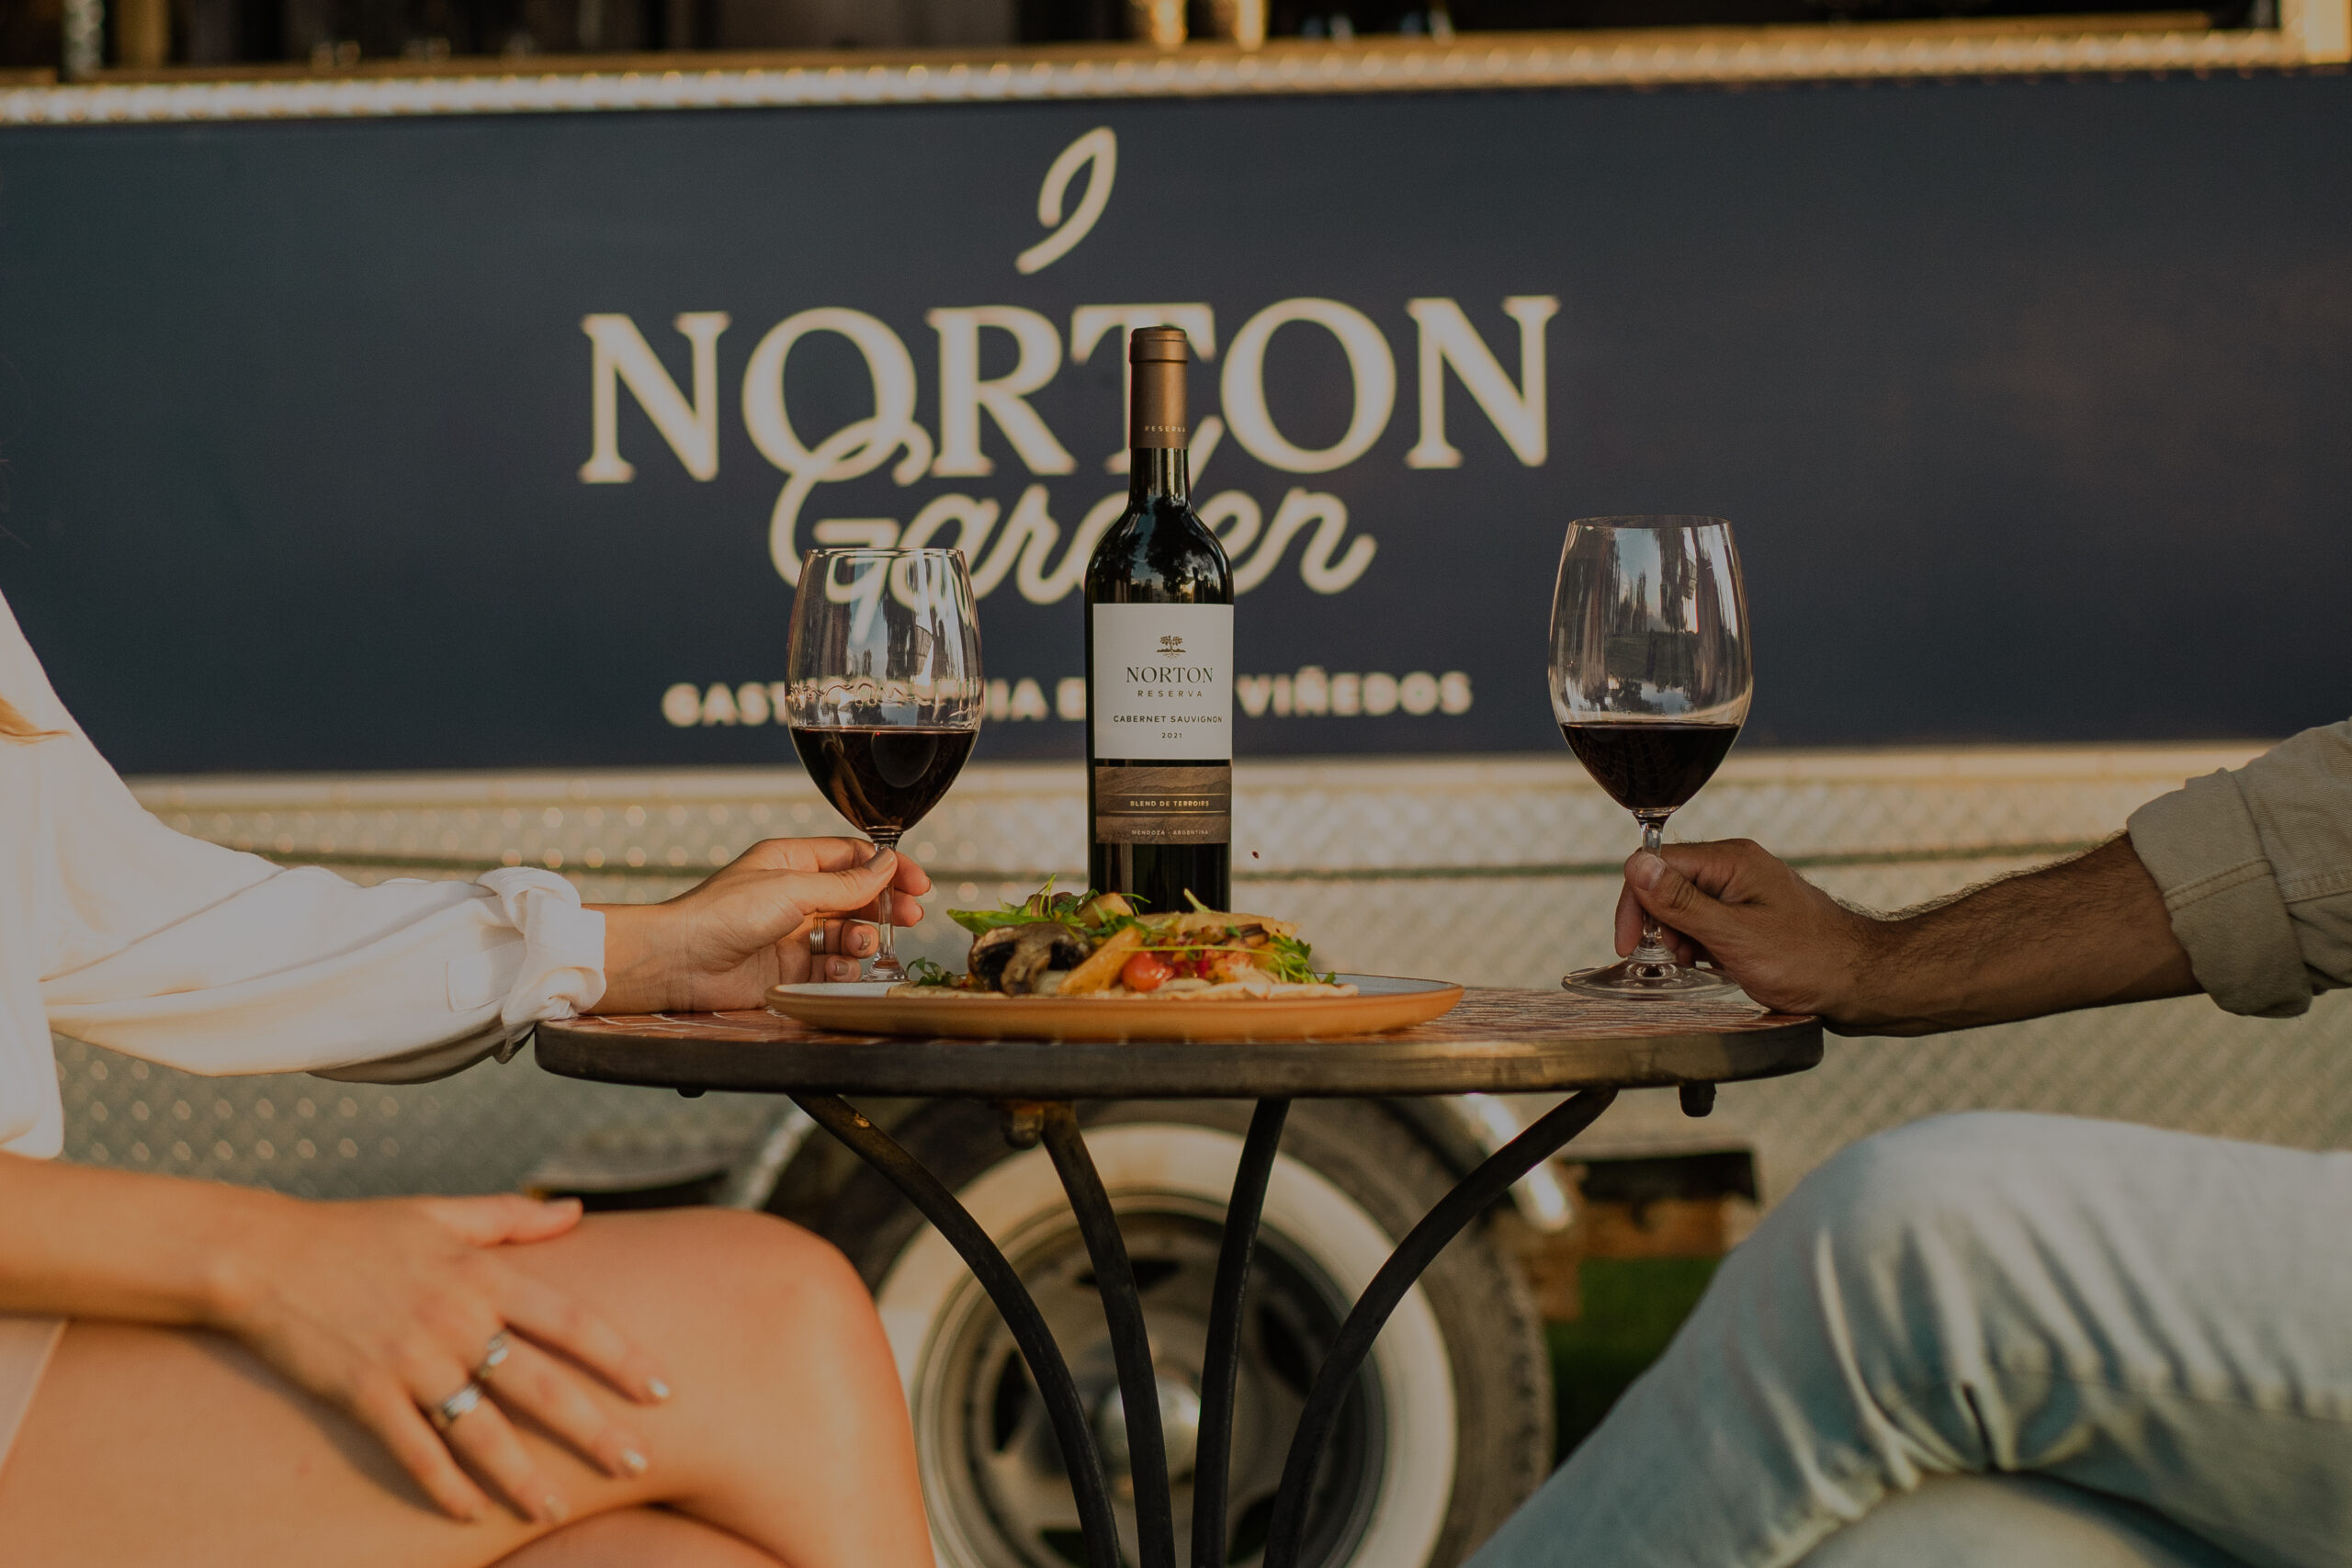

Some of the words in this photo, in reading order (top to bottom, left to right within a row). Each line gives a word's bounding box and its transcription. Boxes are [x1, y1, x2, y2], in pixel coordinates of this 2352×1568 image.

[1126, 666, 1213, 683] NORTON
[1137, 690, 1203, 698] RESERVA
[1236, 665, 1473, 717] VIÑEDOS
[1114, 715, 1167, 723] CABERNET
[1170, 715, 1223, 723] SAUVIGNON
